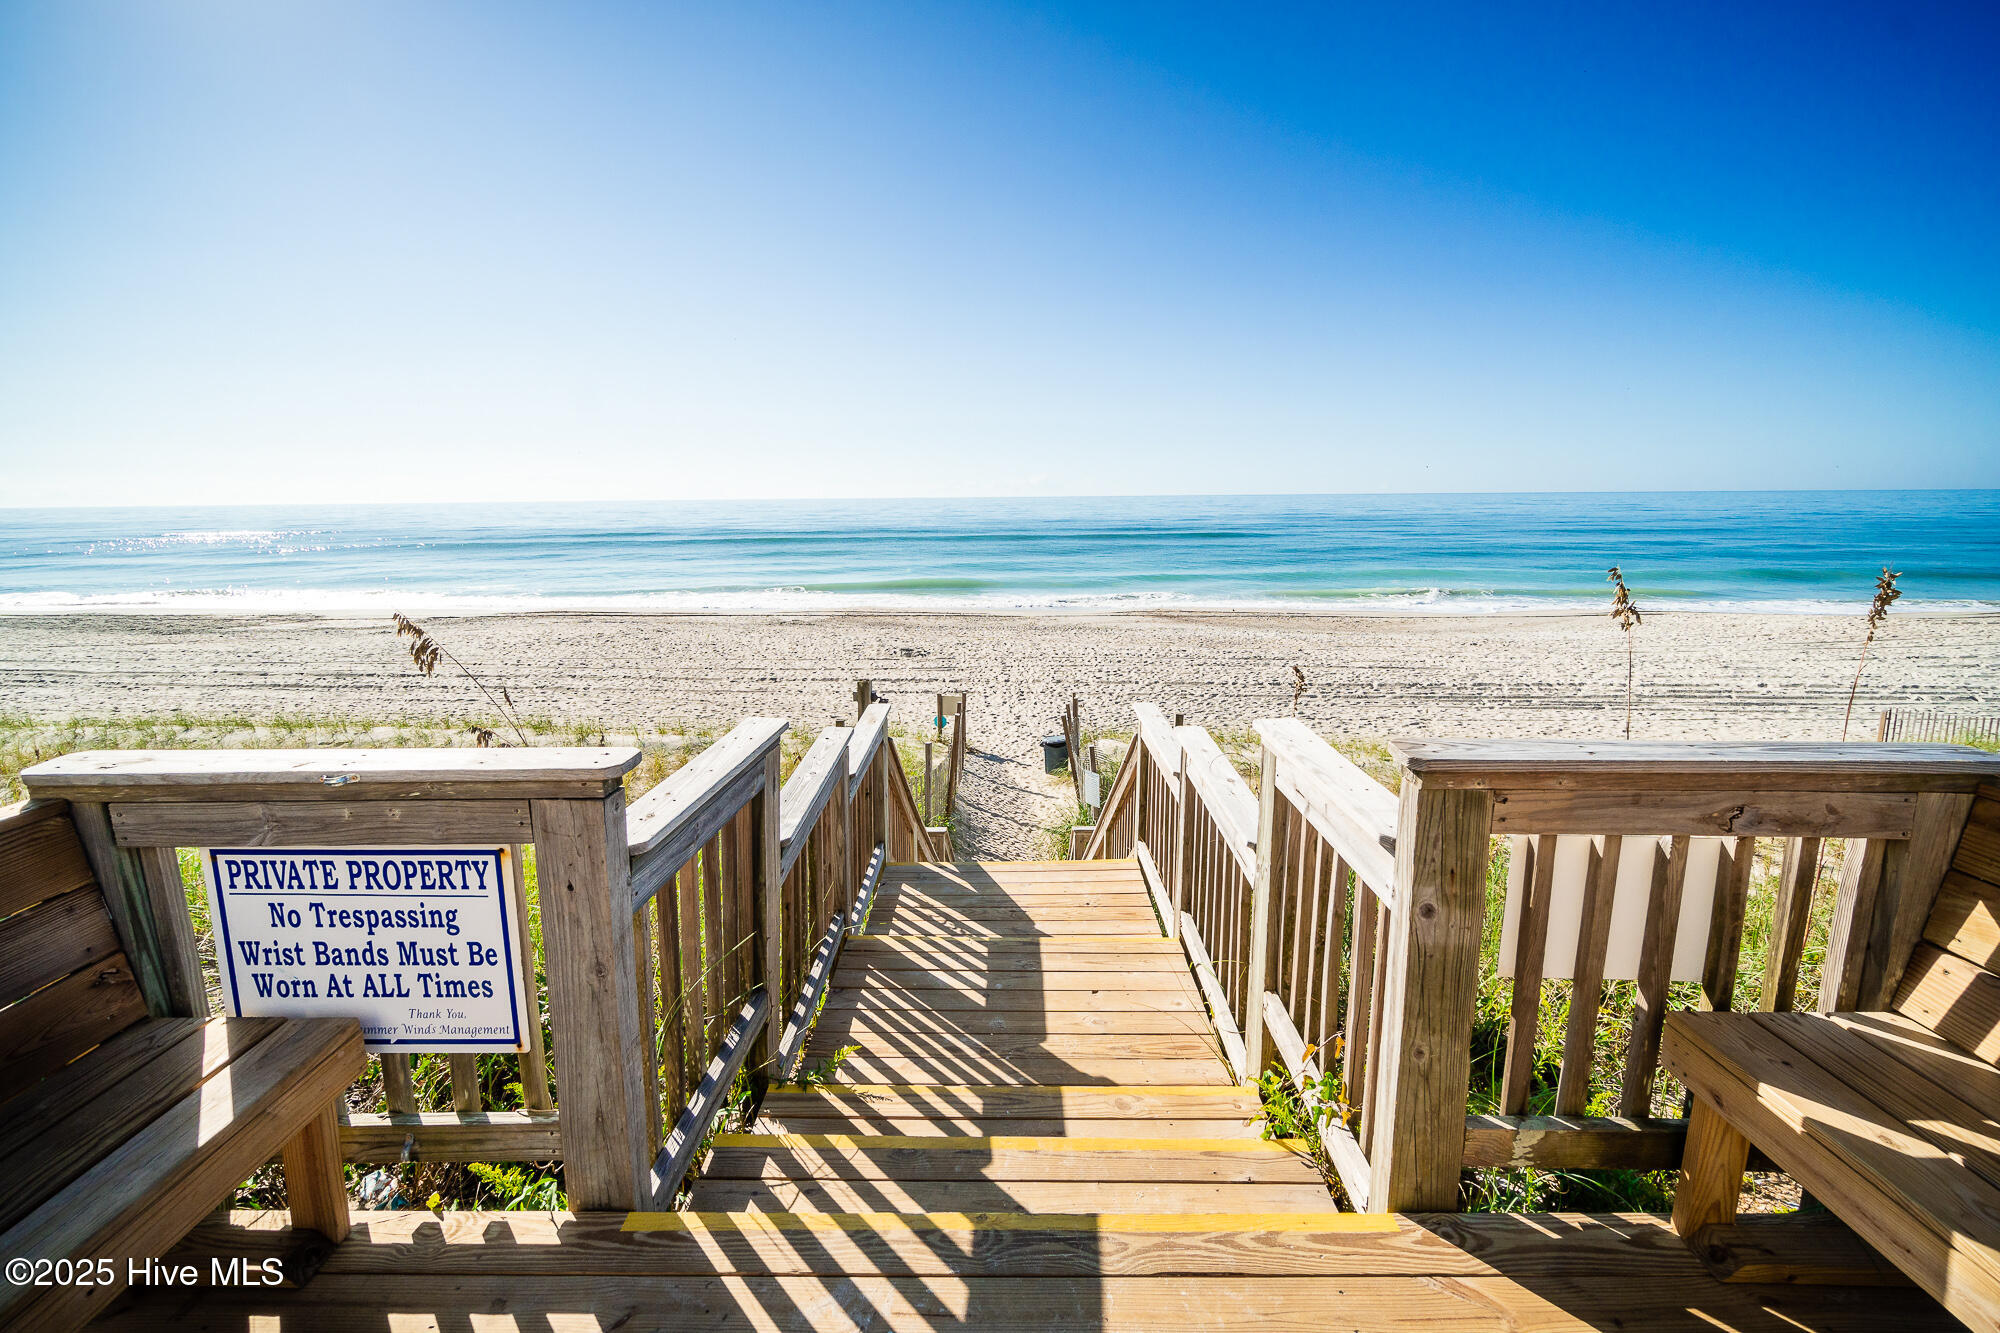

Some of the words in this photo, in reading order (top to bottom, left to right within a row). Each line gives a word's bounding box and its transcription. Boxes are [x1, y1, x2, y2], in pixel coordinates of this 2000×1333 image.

[225, 859, 339, 890] PRIVATE
[346, 859, 489, 891] PROPERTY
[268, 902, 301, 928] No
[309, 902, 460, 936] Trespassing
[238, 940, 306, 966] Wrist
[312, 940, 389, 966] Bands
[396, 941, 459, 966] Must
[466, 941, 498, 966] Be
[252, 973, 319, 998] Worn
[326, 973, 355, 998] At
[363, 973, 410, 998] ALL
[417, 972, 494, 998] Times
[408, 1008, 442, 1019] Thank
[360, 1025, 398, 1035] ummer
[401, 1023, 437, 1035] Winds
[439, 1024, 510, 1038] Management
